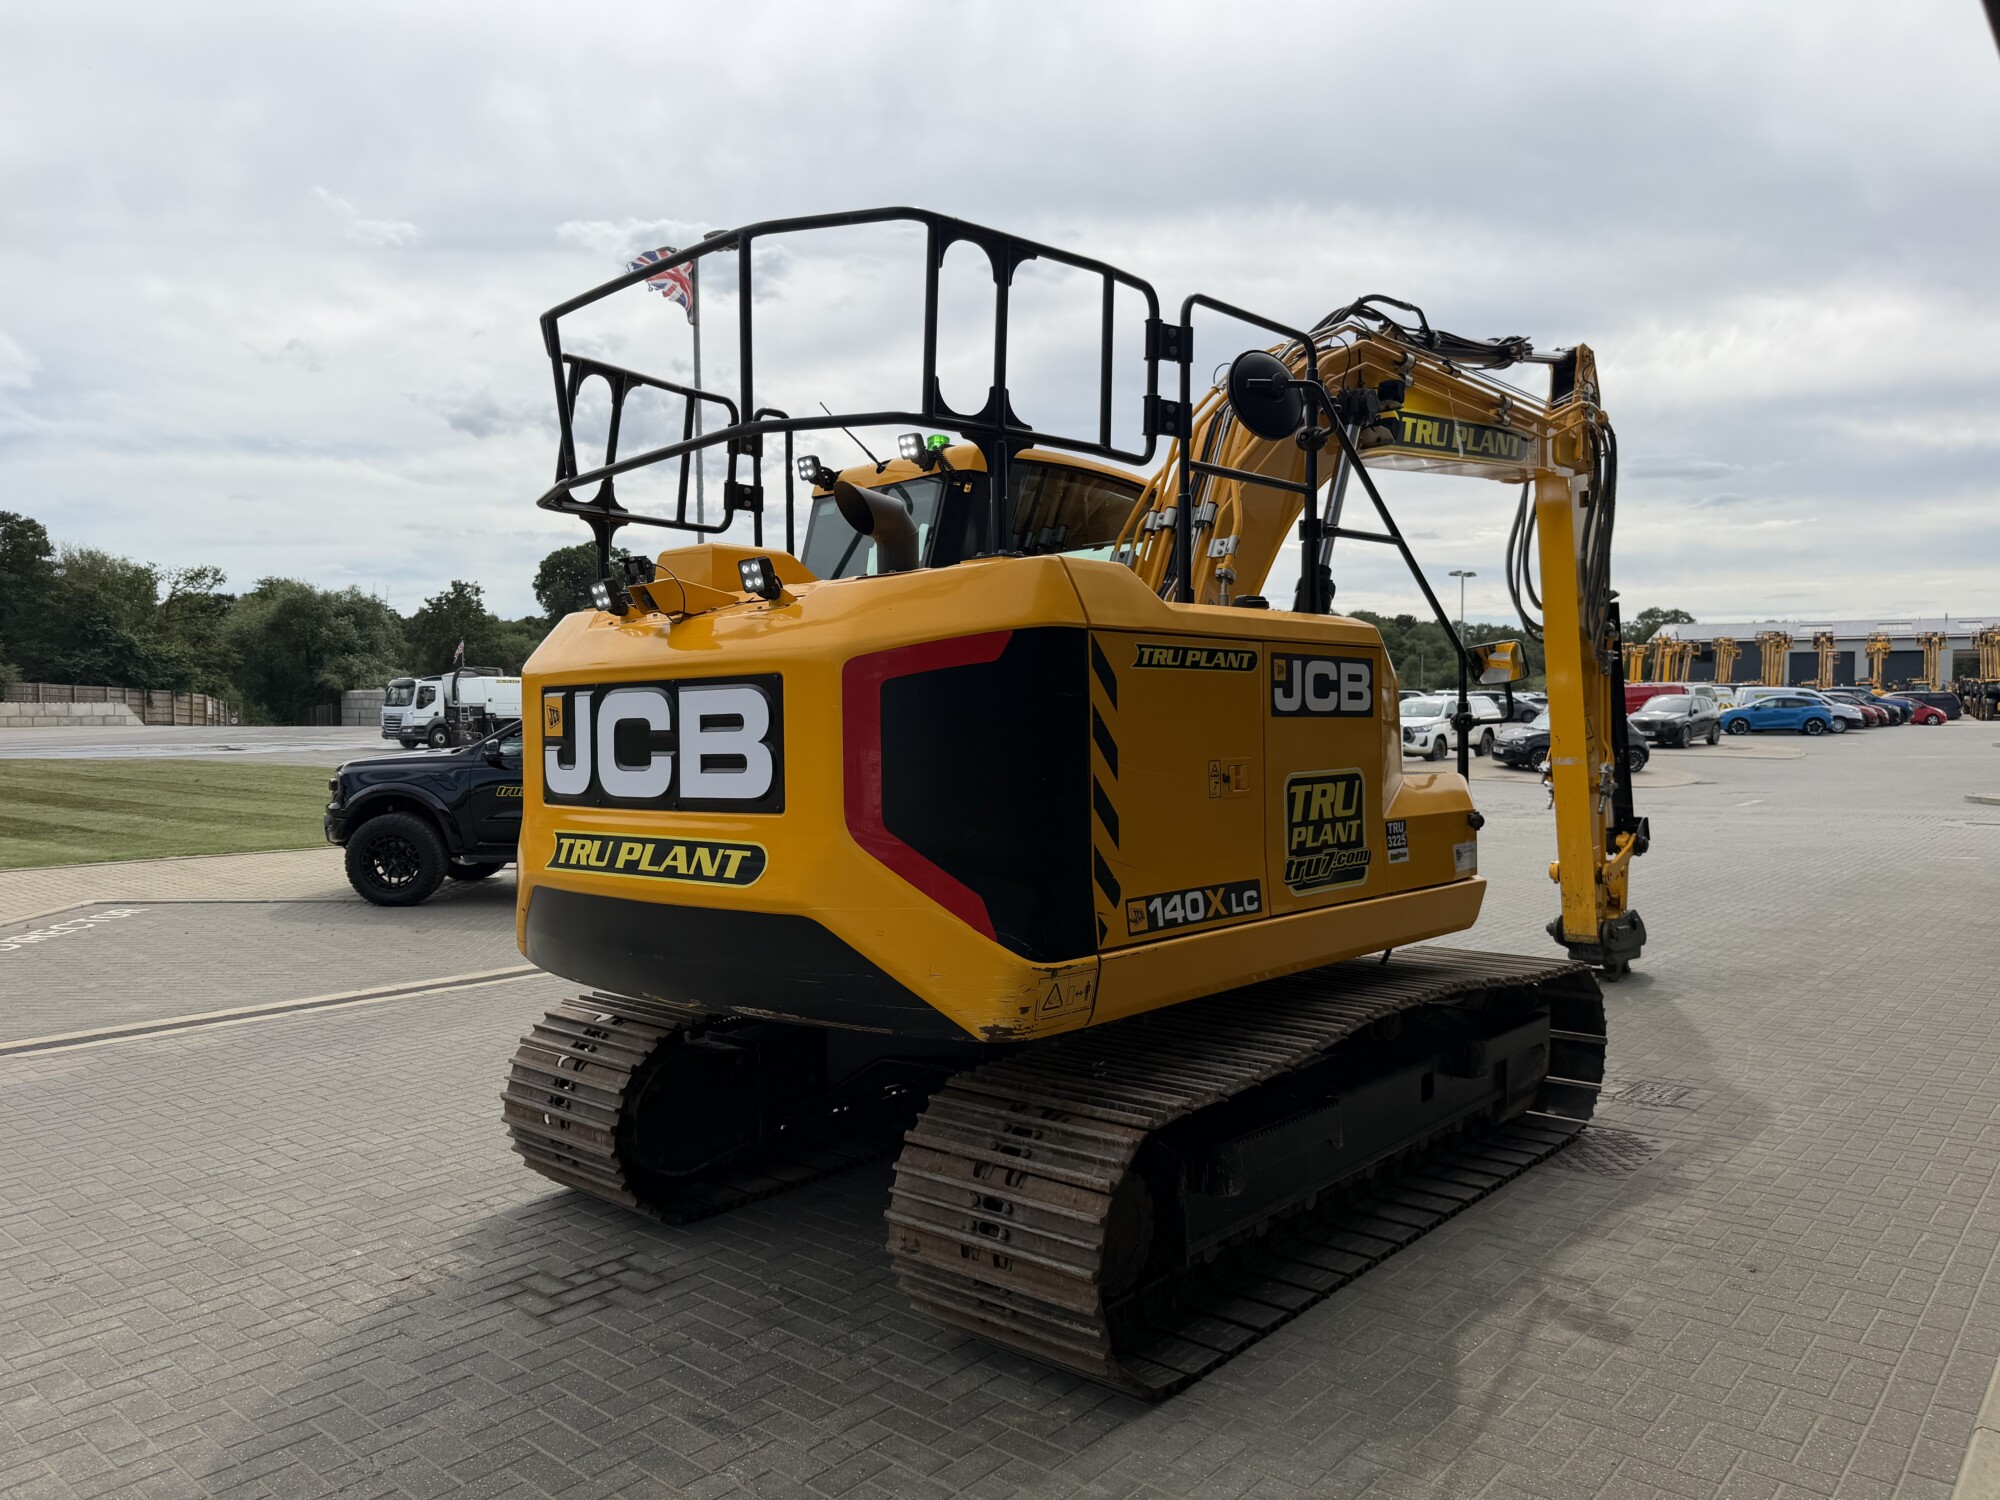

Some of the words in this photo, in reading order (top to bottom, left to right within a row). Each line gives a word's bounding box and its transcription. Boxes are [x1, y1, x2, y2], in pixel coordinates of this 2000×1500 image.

[1402, 417, 1449, 446] TRU
[1452, 426, 1521, 457] PLANT
[1141, 648, 1182, 665] TRU
[1185, 650, 1252, 669] PLANT
[1274, 660, 1371, 712] JCB
[544, 684, 773, 799] JCB
[1290, 780, 1360, 823] TRU
[1291, 820, 1360, 850] PLANT
[1387, 821, 1404, 834] TRU
[1387, 834, 1407, 847] 3225
[558, 838, 614, 867] TRU
[615, 842, 751, 878] PLANT
[1284, 848, 1371, 882] tru7.com
[1148, 887, 1228, 927] 140X
[1231, 890, 1259, 913] LC
